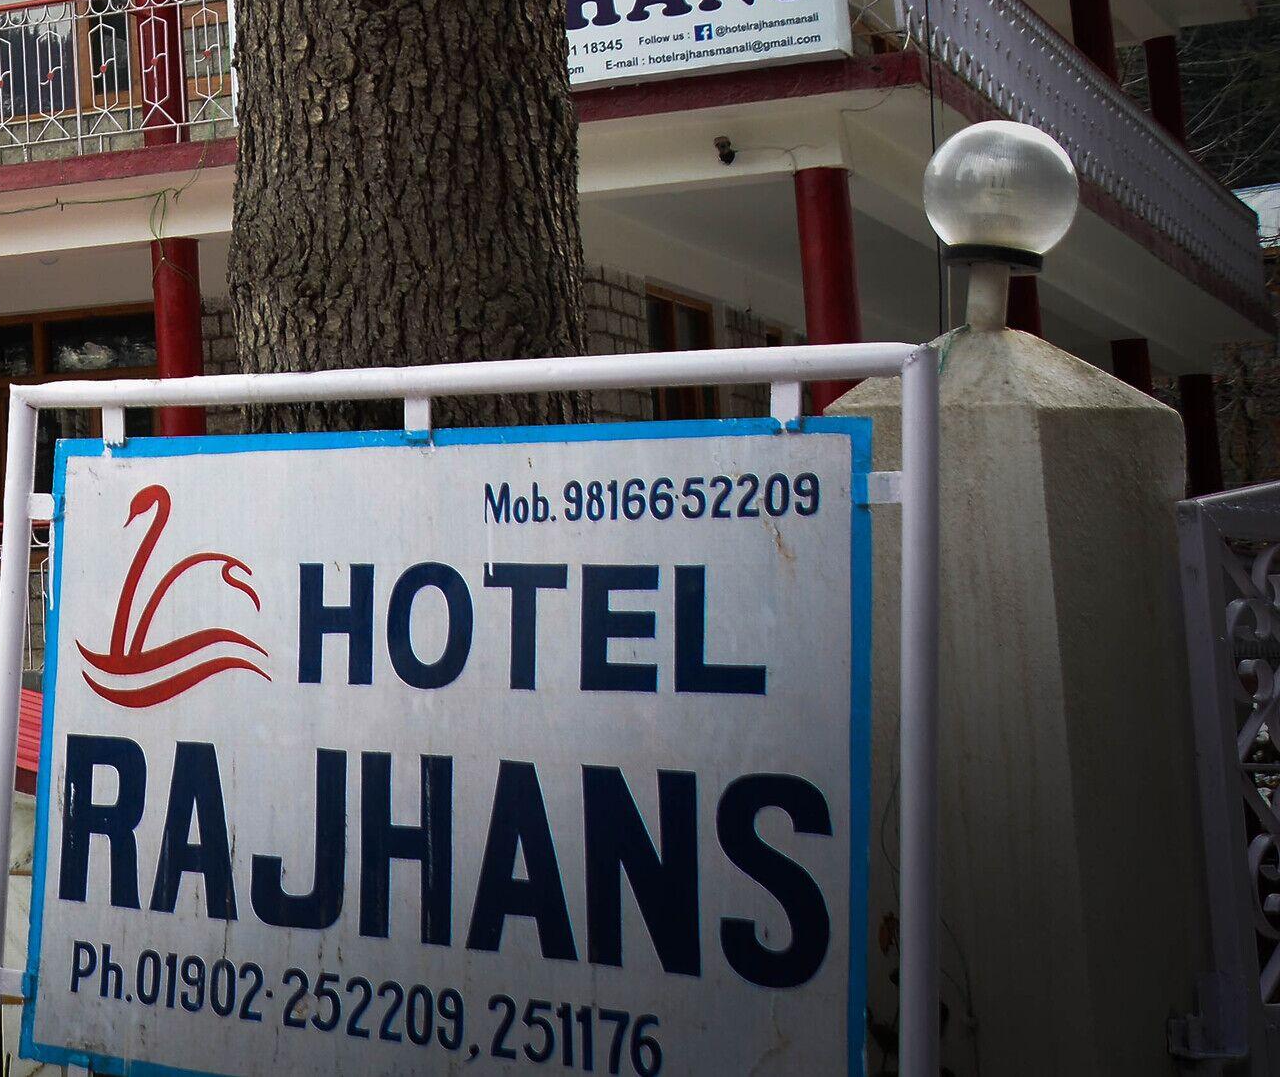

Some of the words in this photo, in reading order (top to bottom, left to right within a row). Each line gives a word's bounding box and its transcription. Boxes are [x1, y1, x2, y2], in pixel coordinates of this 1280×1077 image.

[583, 38, 623, 55] 18345
[638, 33, 671, 46] Follow
[673, 31, 685, 41] us
[605, 57, 639, 70] E-mail
[297, 560, 767, 696] HOTEL
[57, 732, 834, 990] RAJHANS
